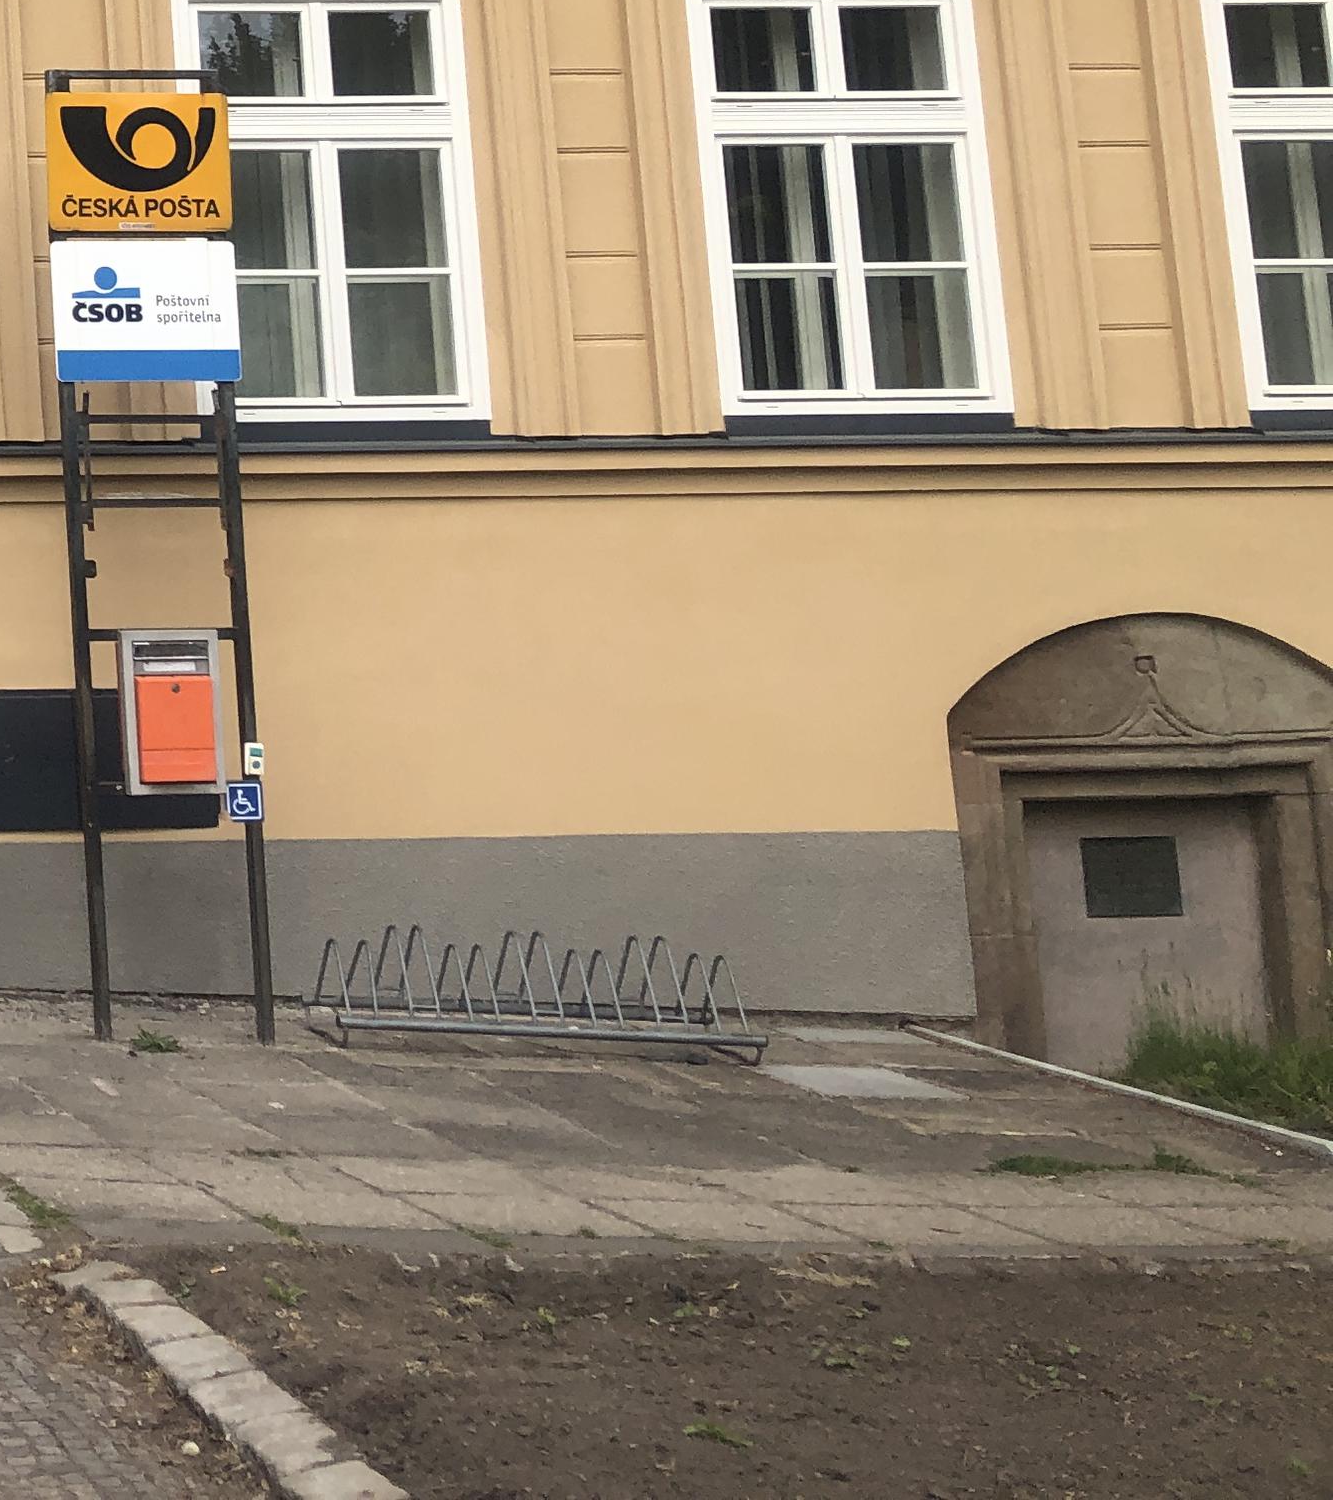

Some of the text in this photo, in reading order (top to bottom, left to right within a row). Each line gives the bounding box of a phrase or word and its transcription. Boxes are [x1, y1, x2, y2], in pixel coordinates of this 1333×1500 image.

[61, 195, 221, 218] ČESKÁ POŠTA
[155, 294, 210, 307] Poštovní
[71, 300, 144, 323] ČSOB
[156, 310, 222, 325] spořitelna
